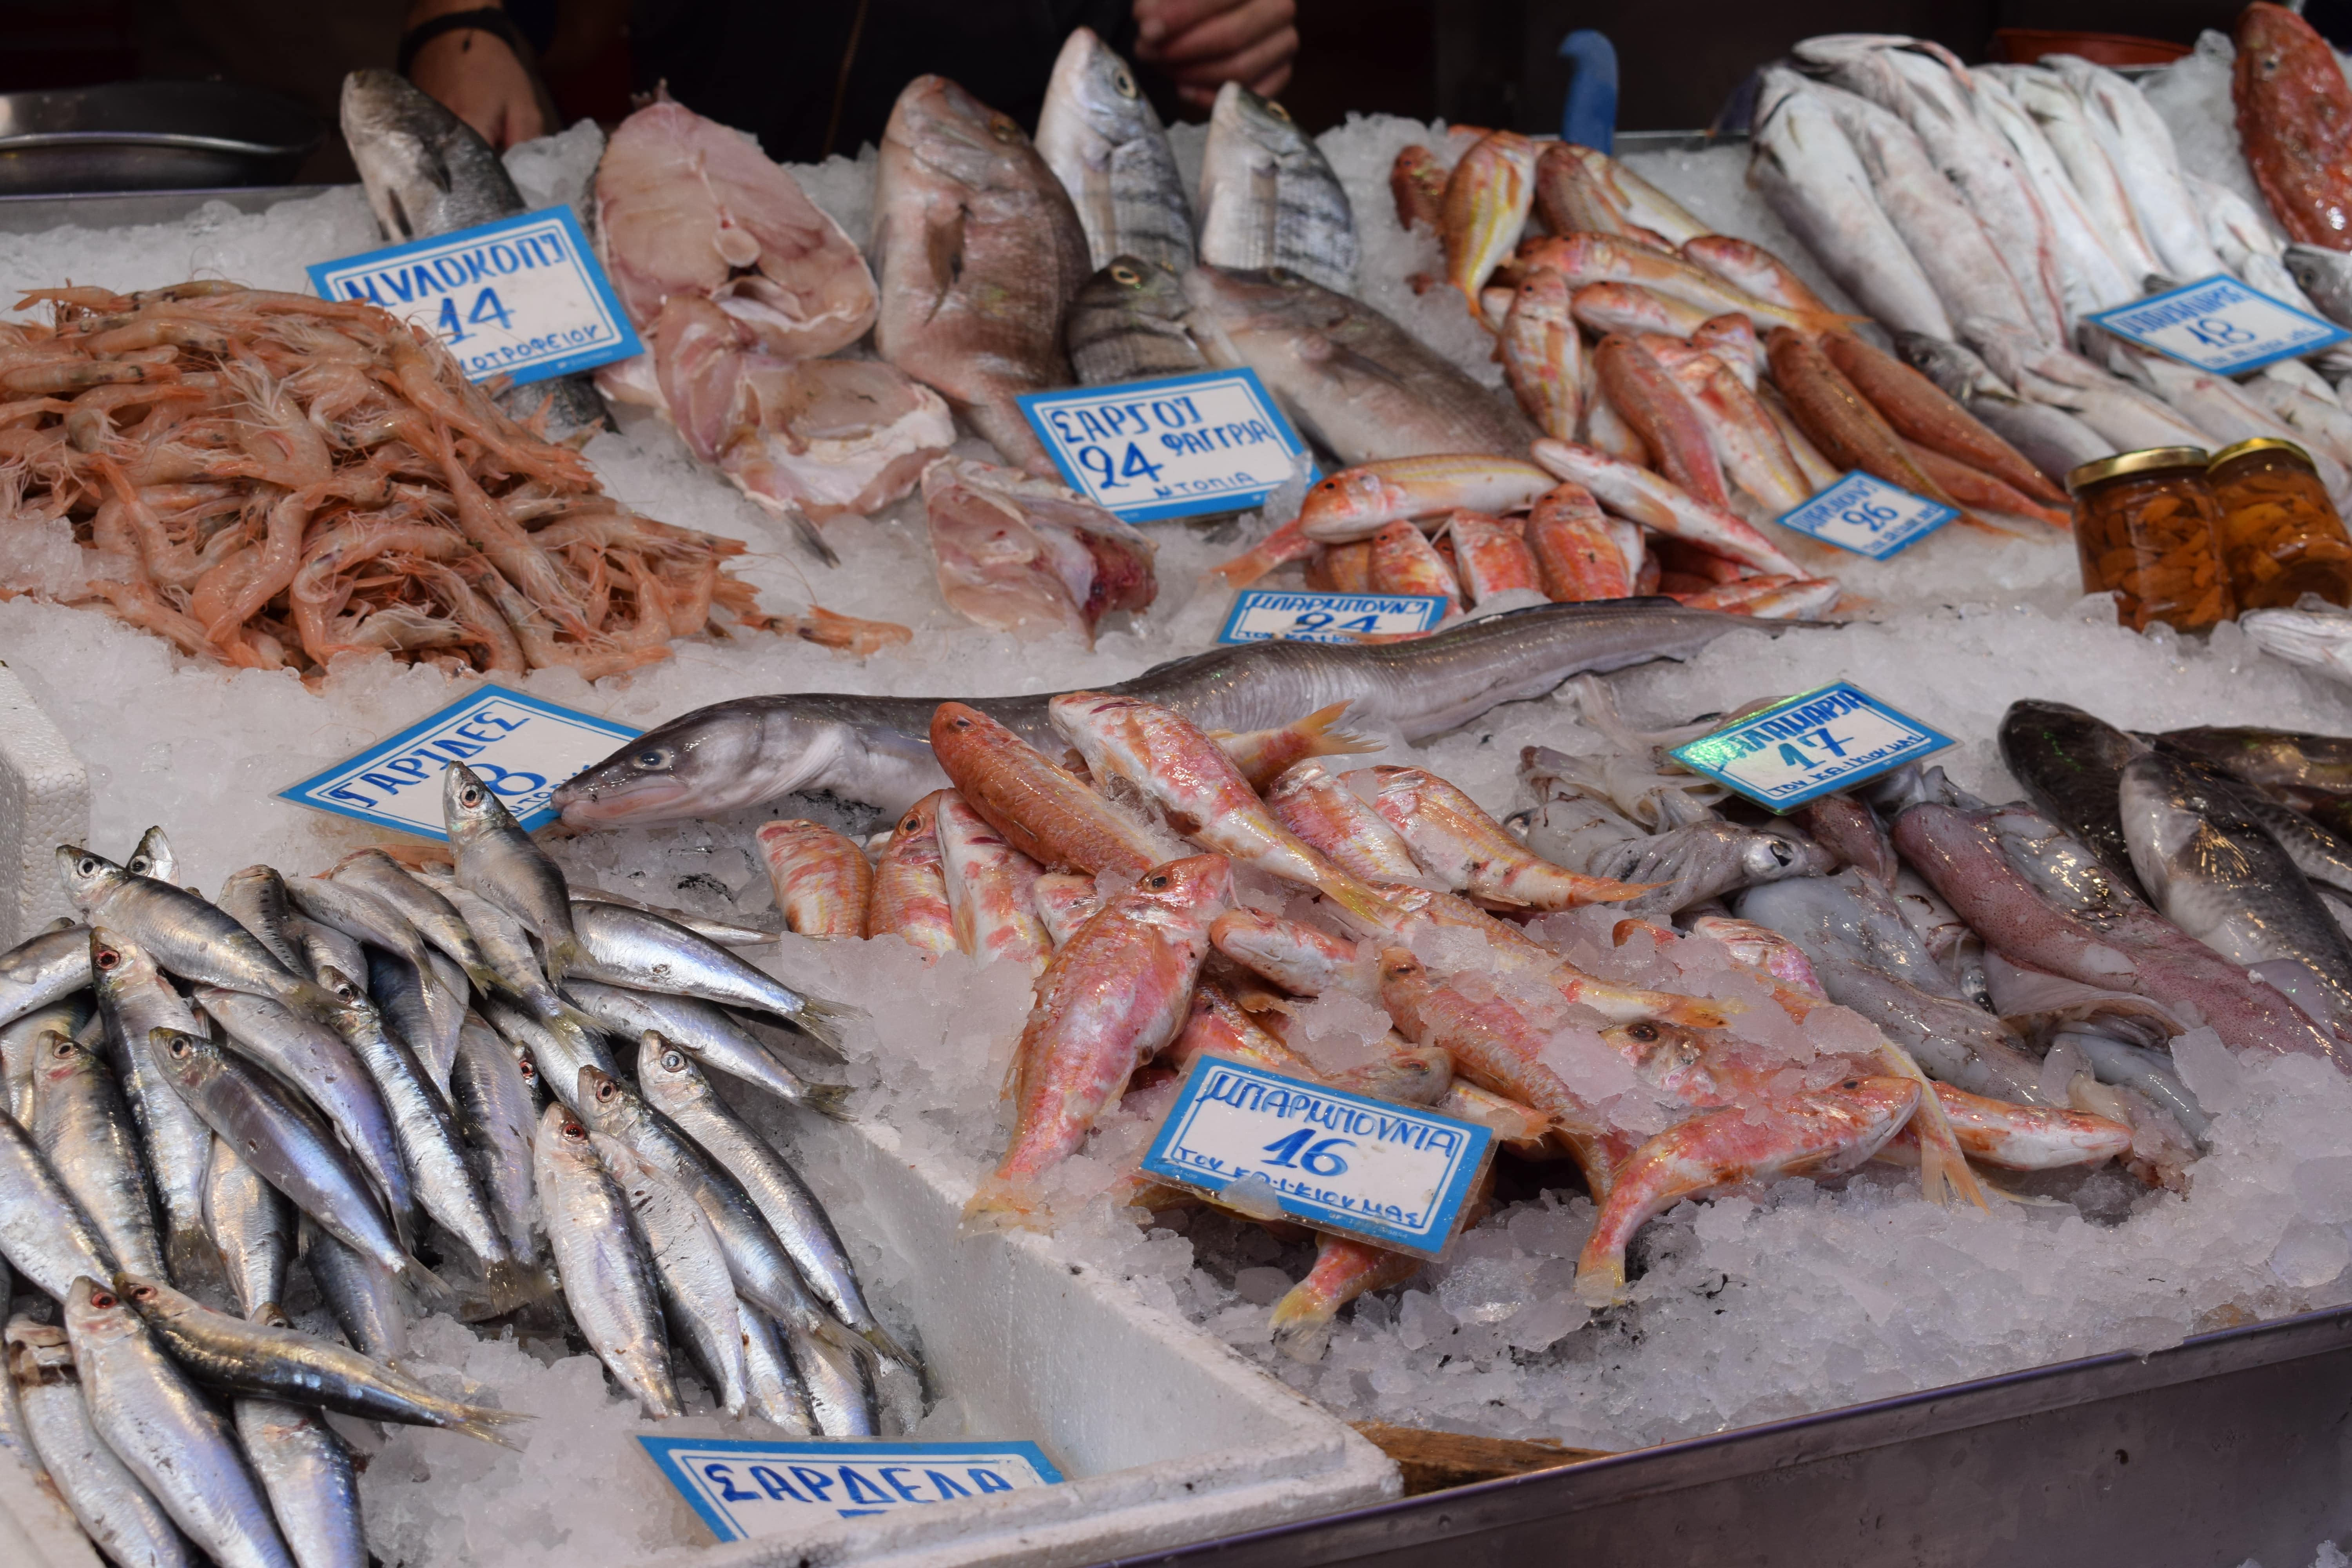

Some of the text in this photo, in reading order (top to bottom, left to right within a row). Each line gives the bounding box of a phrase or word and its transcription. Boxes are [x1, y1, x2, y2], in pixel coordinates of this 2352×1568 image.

[439, 287, 516, 345] 14
[2185, 318, 2256, 348] 18
[1051, 397, 1202, 444] ΣΑΡΓΟΙ
[1078, 442, 1163, 489] 24
[1292, 612, 1381, 633] 24
[1711, 689, 1871, 772] ΑΛΑΜΑΡΙΑ
[1778, 728, 1854, 771] 17
[328, 711, 530, 808] ΓΑΡΙΔΕΣ
[1767, 780, 1808, 793] ΤΟΥ
[1197, 1074, 1457, 1157] ΜΠΑΡΜΠΟΥΝΙΑ
[1261, 1128, 1356, 1176] 16
[1180, 1146, 1223, 1170] ΤΟΥ
[1362, 1198, 1424, 1229] ΜΑΣ
[704, 1463, 1014, 1504] ΣΑΡΔΕΛΑ
